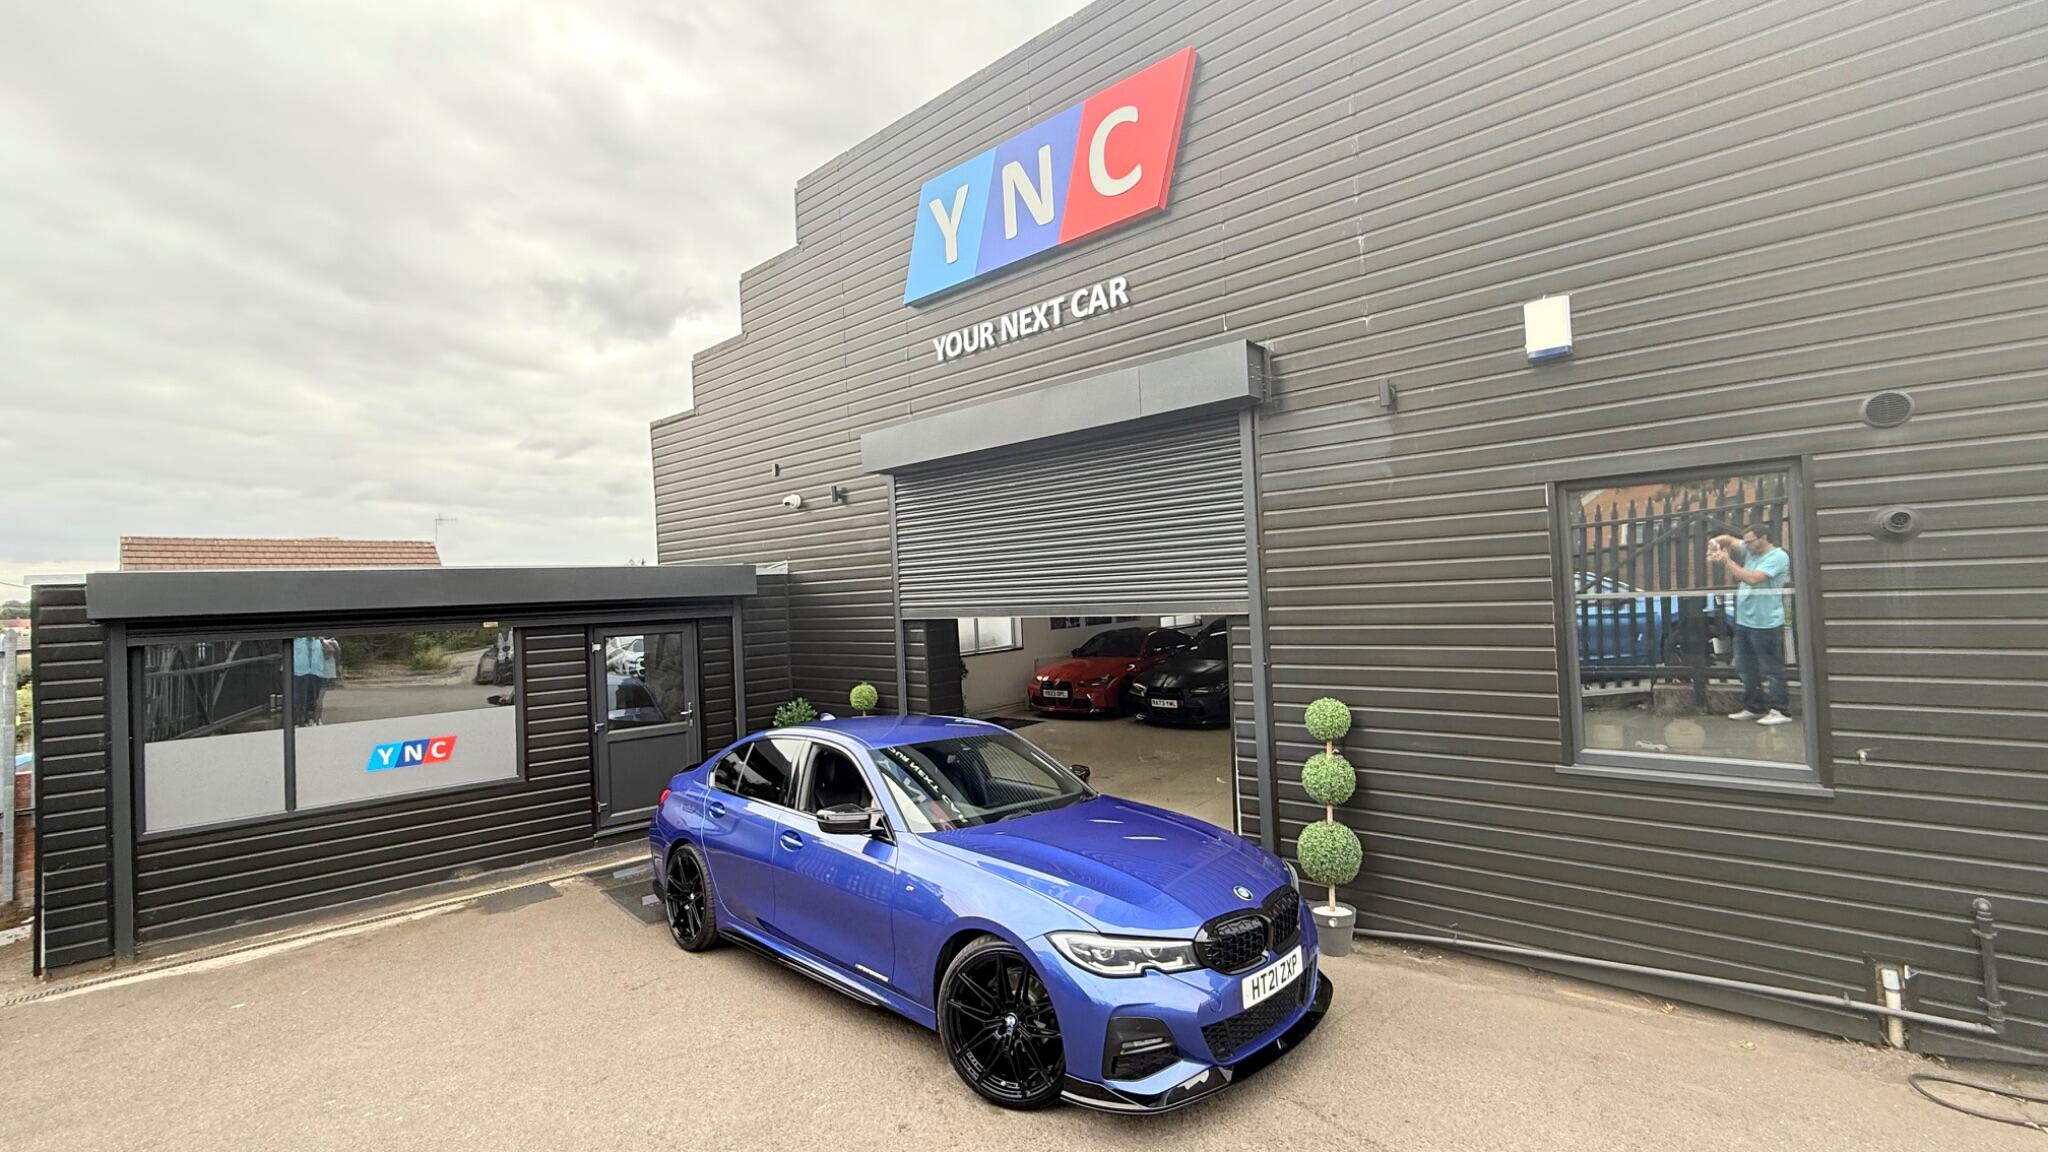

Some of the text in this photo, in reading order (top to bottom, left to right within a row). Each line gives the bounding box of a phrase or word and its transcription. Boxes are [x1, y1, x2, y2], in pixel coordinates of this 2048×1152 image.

[929, 105, 1143, 265] YNC
[932, 276, 1130, 362] YOUR NEXT CAR
[377, 741, 447, 766] YNC
[1251, 954, 1297, 1001] HT21 ZXP
